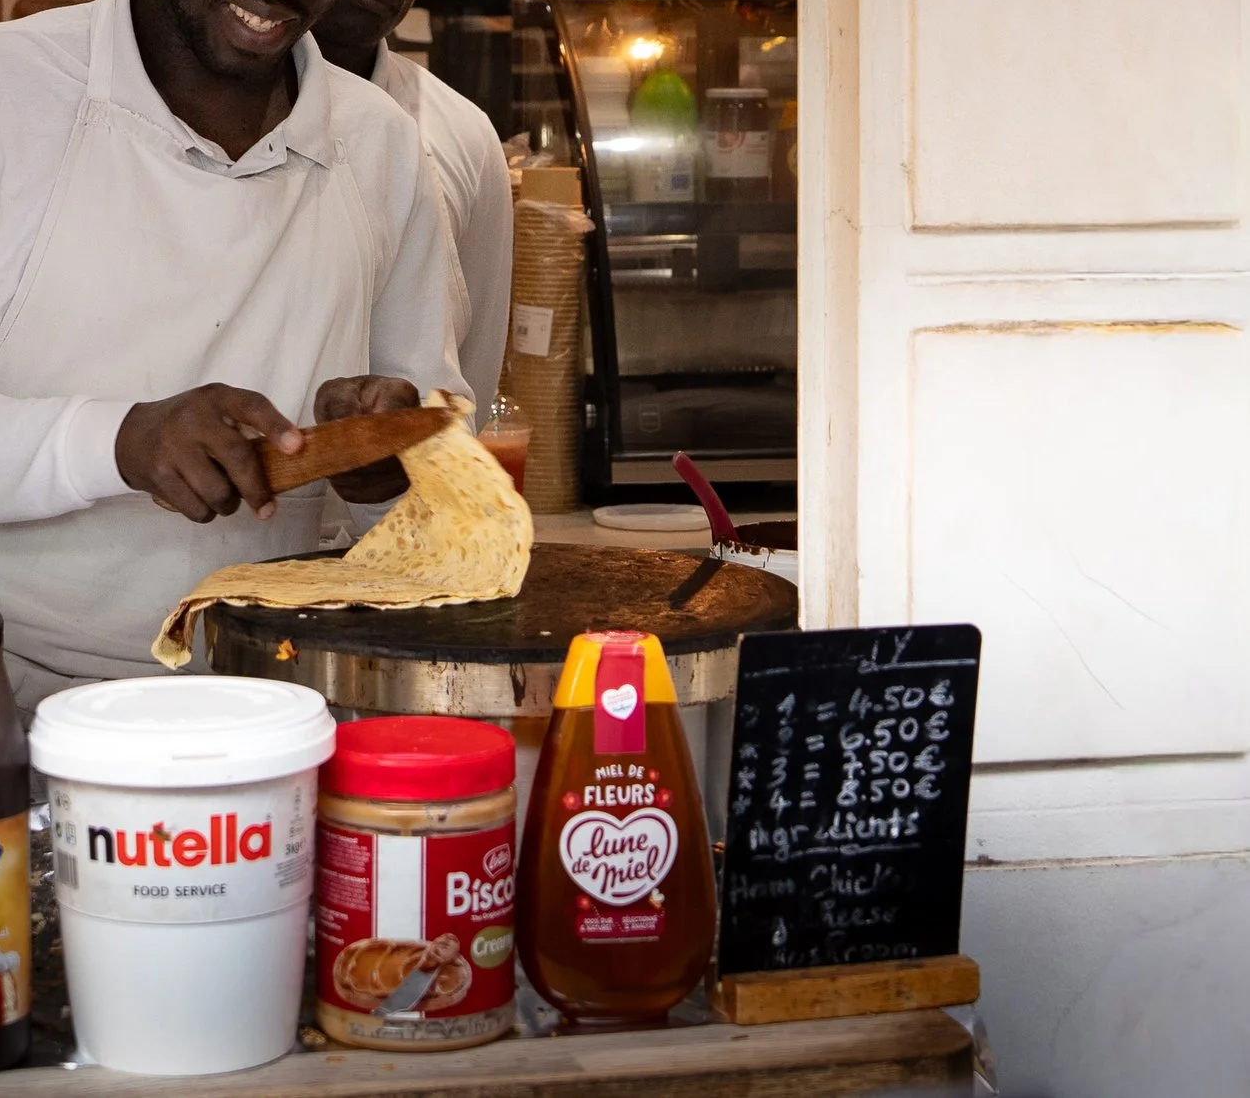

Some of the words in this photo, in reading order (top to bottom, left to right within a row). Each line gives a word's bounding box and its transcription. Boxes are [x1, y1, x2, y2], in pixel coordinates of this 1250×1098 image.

[848, 678, 954, 719] 4.50€
[839, 709, 951, 751] 6.50€
[595, 764, 624, 780] MIEL
[628, 763, 645, 779] DE
[583, 783, 655, 806] FLEURS
[836, 773, 942, 807] 8.50€
[88, 813, 272, 868] nutella
[582, 826, 649, 860] lune
[572, 856, 591, 875] de
[591, 844, 661, 894] miel
[134, 884, 169, 897] FOOD
[175, 883, 227, 897] SERVICE
